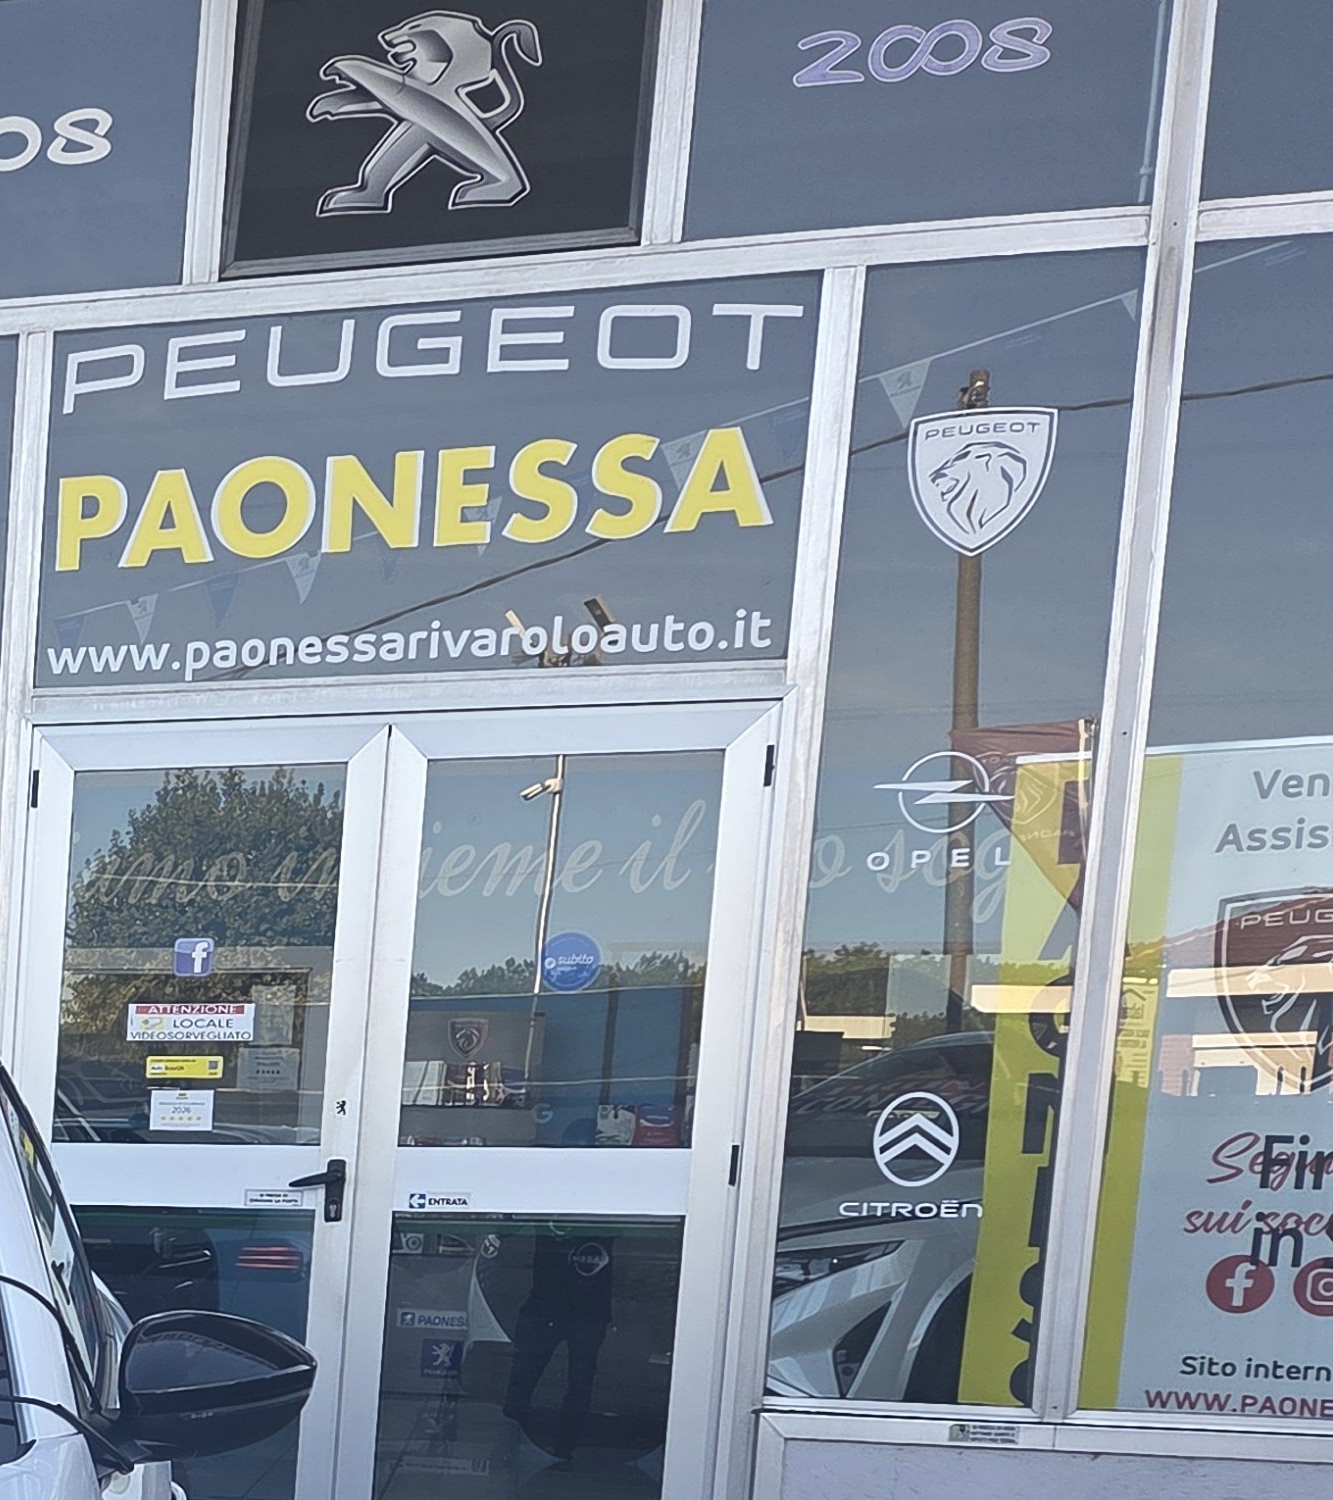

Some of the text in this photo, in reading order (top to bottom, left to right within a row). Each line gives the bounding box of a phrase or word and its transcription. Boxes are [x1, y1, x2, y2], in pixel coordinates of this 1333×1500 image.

[792, 17, 1053, 88] 2008
[62, 303, 805, 415] PEUGEOT
[924, 421, 1041, 441] PEUGEOT
[54, 425, 774, 573] PAONESSA
[47, 608, 772, 681] www.paonessarivaroloauto.it
[1252, 768, 1332, 800] Ven
[866, 847, 1012, 872] OPEL
[148, 1004, 238, 1015] ATTENZIONE
[130, 1031, 252, 1041] VIDEOSORVEGLIATO
[173, 1018, 234, 1029] LOCALE
[428, 1197, 468, 1206] ENTRATA
[1183, 1199, 1253, 1234] sui
[418, 1315, 469, 1327] PAONES
[1180, 1355, 1332, 1383] Sito intern
